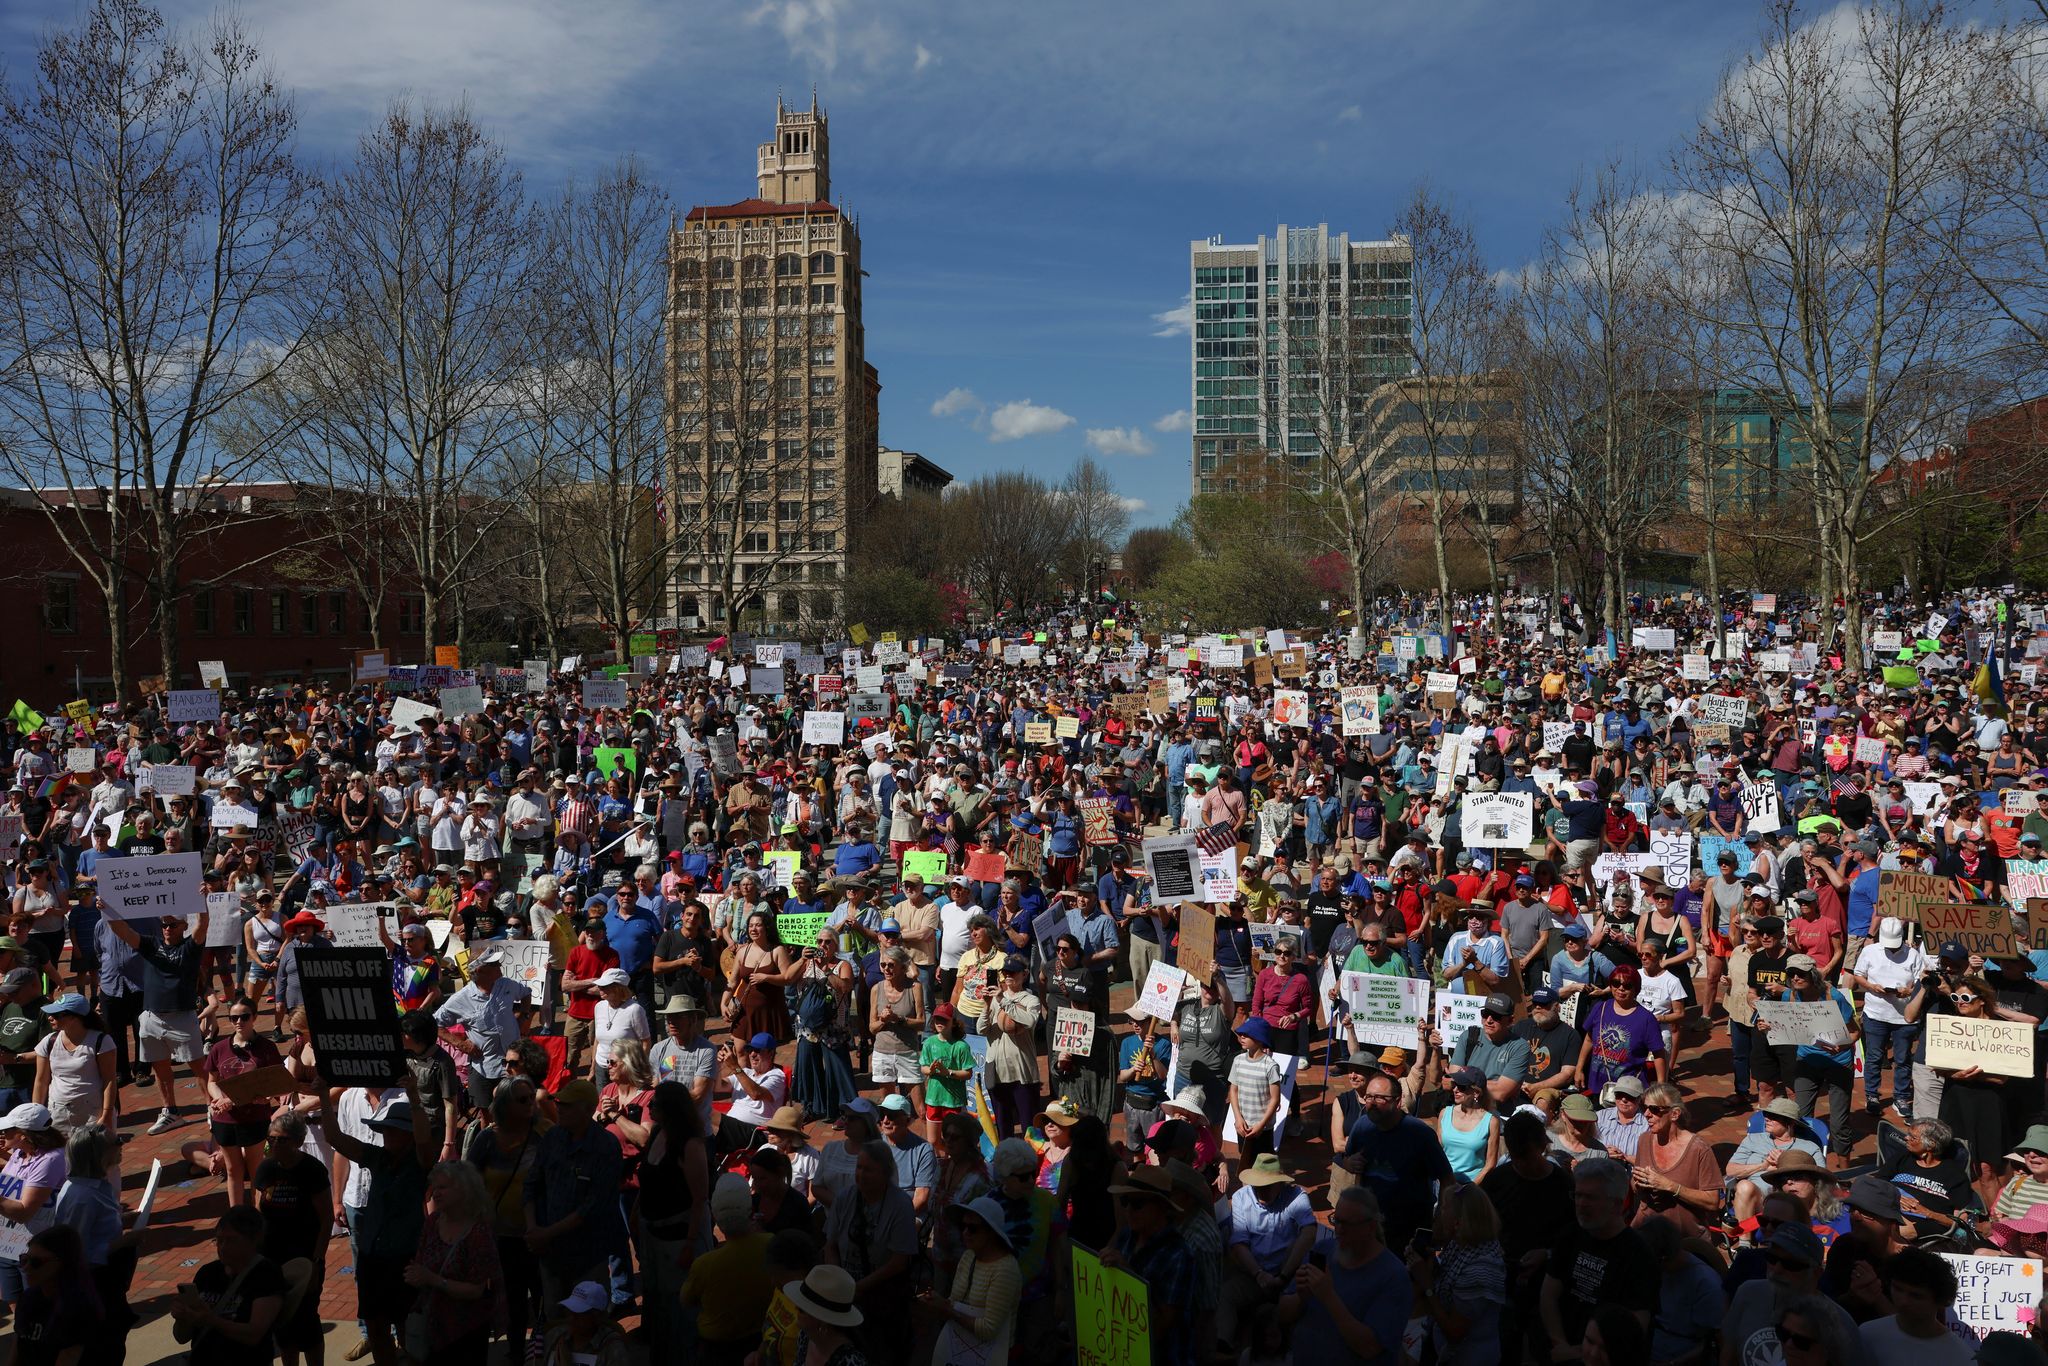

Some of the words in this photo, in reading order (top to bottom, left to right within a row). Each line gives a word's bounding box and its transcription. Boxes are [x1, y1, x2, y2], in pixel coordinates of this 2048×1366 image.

[1346, 688, 1367, 698] HANDS
[1367, 687, 1376, 696] OFF
[170, 695, 202, 707] HANDS
[205, 693, 218, 703] OFF
[1196, 698, 1217, 706] RESIST
[1708, 694, 1728, 708] Hands
[1730, 700, 1745, 710] off
[172, 708, 218, 720] DEMOCRACY
[857, 704, 882, 712] RESIST
[1196, 706, 1217, 717] EVIL
[1708, 706, 1728, 716] SSI
[1705, 715, 1744, 726] Medicare
[1545, 732, 1560, 742] EVEN
[1547, 738, 1564, 748] THAN
[1860, 743, 1883, 752] ELON
[1740, 783, 1774, 804] HANDS
[1080, 799, 1098, 809] FISTS
[1099, 798, 1108, 808] UP
[1472, 794, 1494, 806] STAND
[1499, 794, 1524, 808] UNITED
[1743, 793, 1775, 820] OFF
[1604, 854, 1639, 862] RESPECT
[1668, 832, 1690, 888] HANDS
[110, 869, 130, 880] It's
[147, 866, 188, 876] Democracy,
[114, 882, 130, 892] and
[144, 880, 164, 888] intend
[1894, 874, 1937, 896] MUSK
[124, 896, 150, 906] KEEP
[209, 894, 224, 902] OFF
[1926, 908, 1982, 929] SAVE
[1986, 910, 2003, 930] OUR
[1924, 931, 2012, 954] DEMOCRACY
[522, 946, 548, 967] OFF
[302, 960, 356, 978] HANDS
[356, 960, 382, 977] OFF
[321, 988, 376, 1020] NIH
[1059, 1008, 1078, 1019] Even
[1082, 1013, 1093, 1022] the
[1353, 1012, 1364, 1020] $$
[1405, 1016, 1416, 1024] $$
[1932, 1017, 1950, 1034] I
[1950, 1022, 2027, 1042] SUPPORT
[318, 1034, 396, 1052] RESEARCH
[1055, 1036, 1082, 1048] VERTS
[1358, 1031, 1406, 1046] TRUTH
[1930, 1034, 1976, 1052] FEDERAL
[1978, 1039, 2030, 1058] WORKERS
[331, 1060, 391, 1077] GRANTS
[1976, 1261, 2014, 1277] GREAT
[1076, 1260, 1150, 1333] HANDS
[1984, 1292, 1988, 1304] I
[1999, 1292, 2032, 1304] JUST
[1959, 1304, 2005, 1320] FEEL
[1096, 1309, 1140, 1356] OFF
